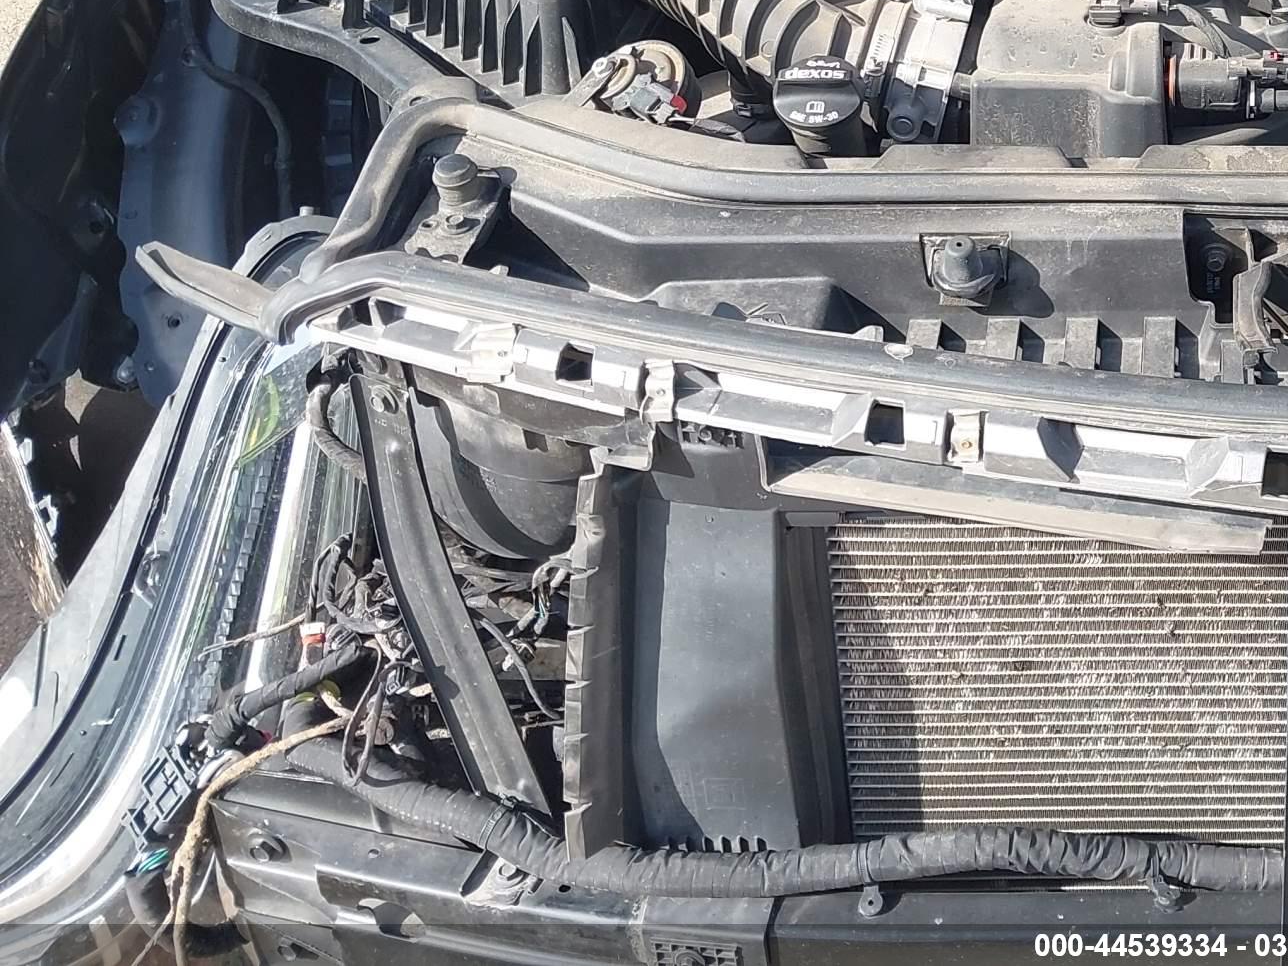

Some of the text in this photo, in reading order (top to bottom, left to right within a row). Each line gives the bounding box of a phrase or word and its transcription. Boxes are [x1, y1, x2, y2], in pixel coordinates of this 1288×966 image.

[785, 67, 847, 79] dexos
[790, 111, 838, 123] SAE 5W-30
